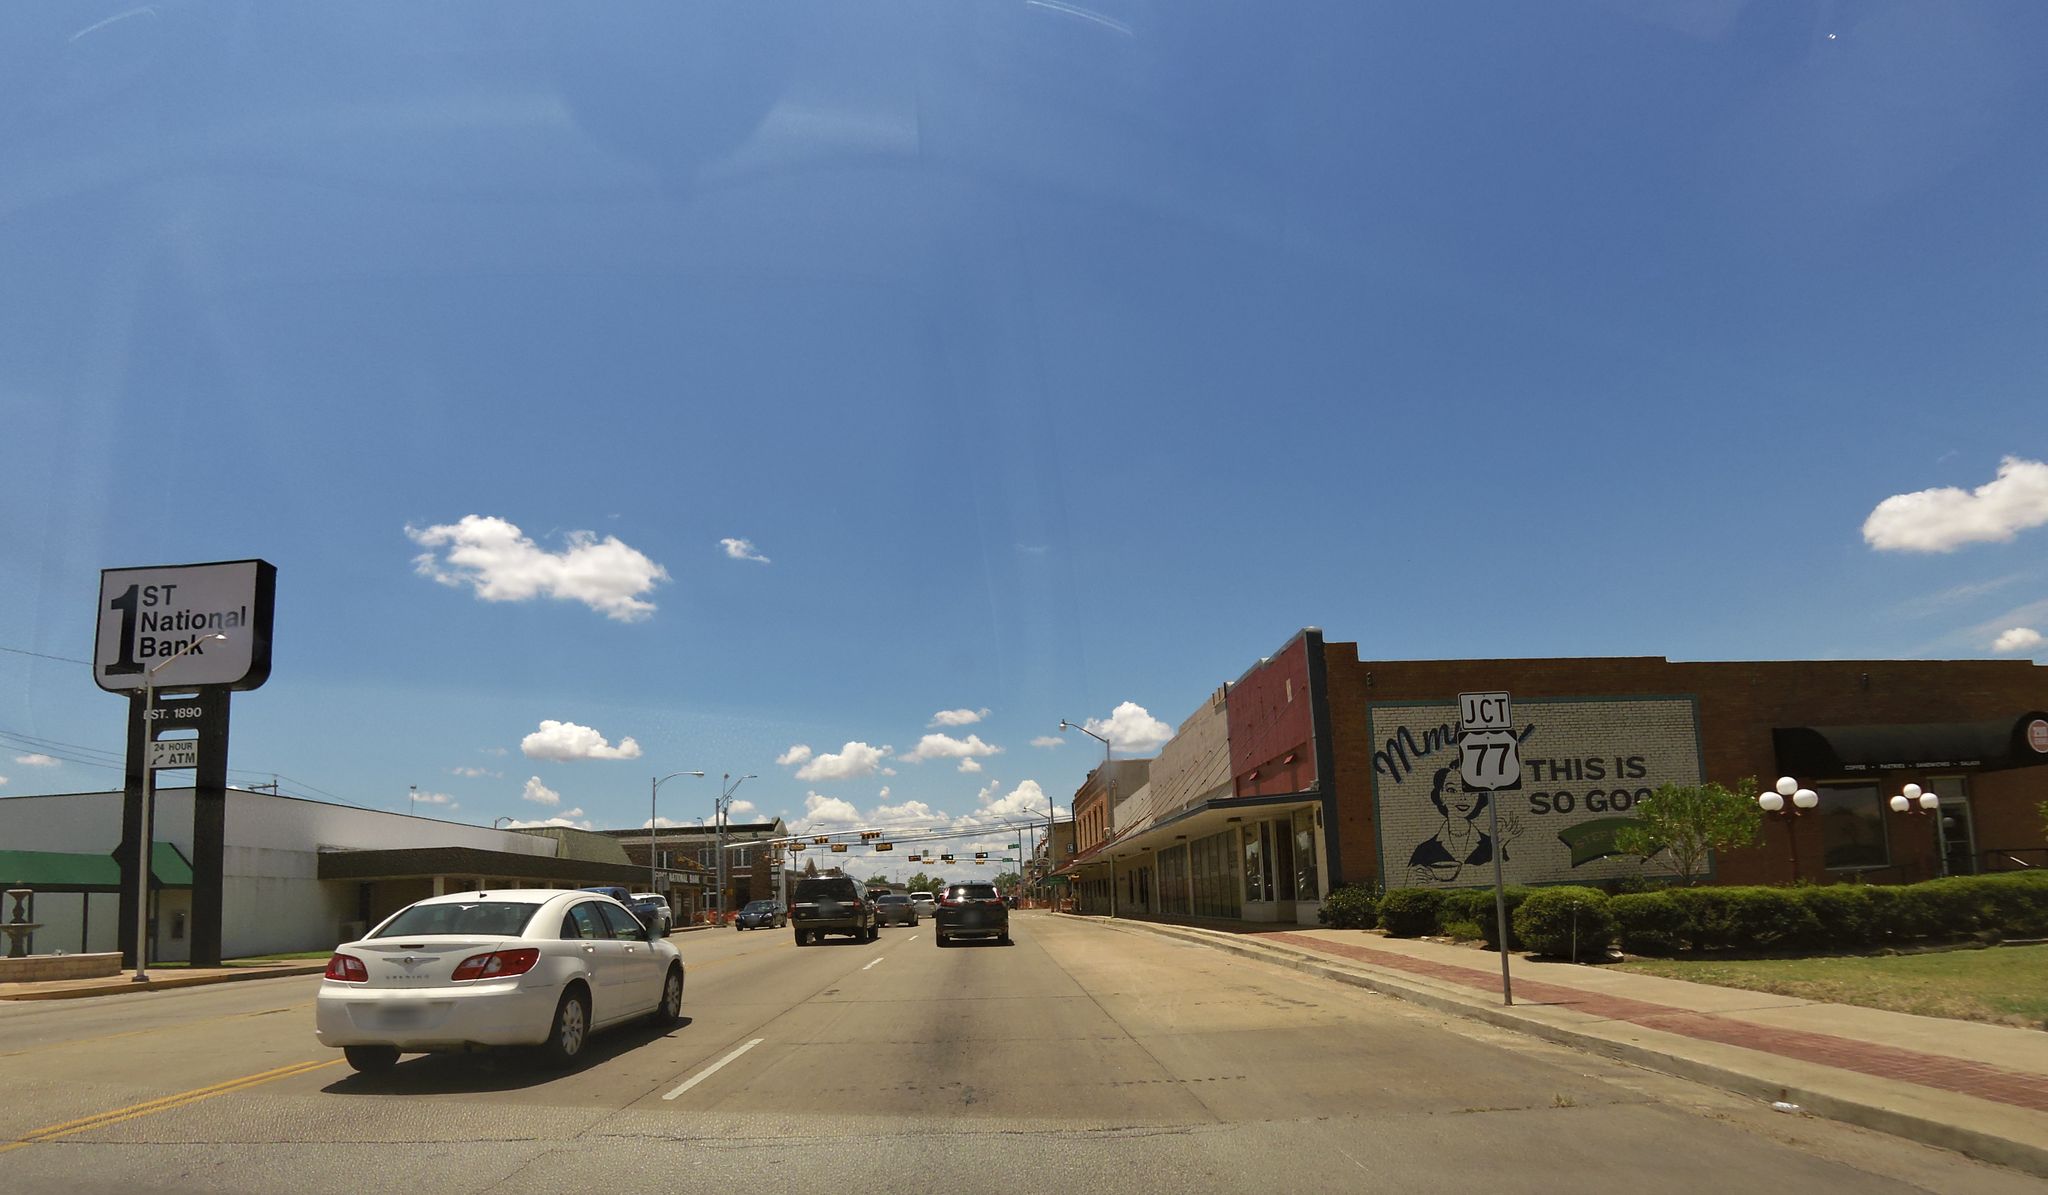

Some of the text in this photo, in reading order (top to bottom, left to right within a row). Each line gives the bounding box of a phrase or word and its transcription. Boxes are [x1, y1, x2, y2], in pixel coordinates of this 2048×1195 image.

[105, 584, 177, 675] 1 ST
[141, 606, 246, 632] National
[139, 634, 204, 659] Bank
[173, 706, 203, 720] 1890
[1464, 698, 1507, 725] JCT
[154, 742, 193, 751] 24 HOUR
[168, 753, 195, 764] ATM
[1467, 742, 1511, 777] 77
[1526, 755, 1648, 783] THIS IS
[1529, 790, 1576, 816] SO
